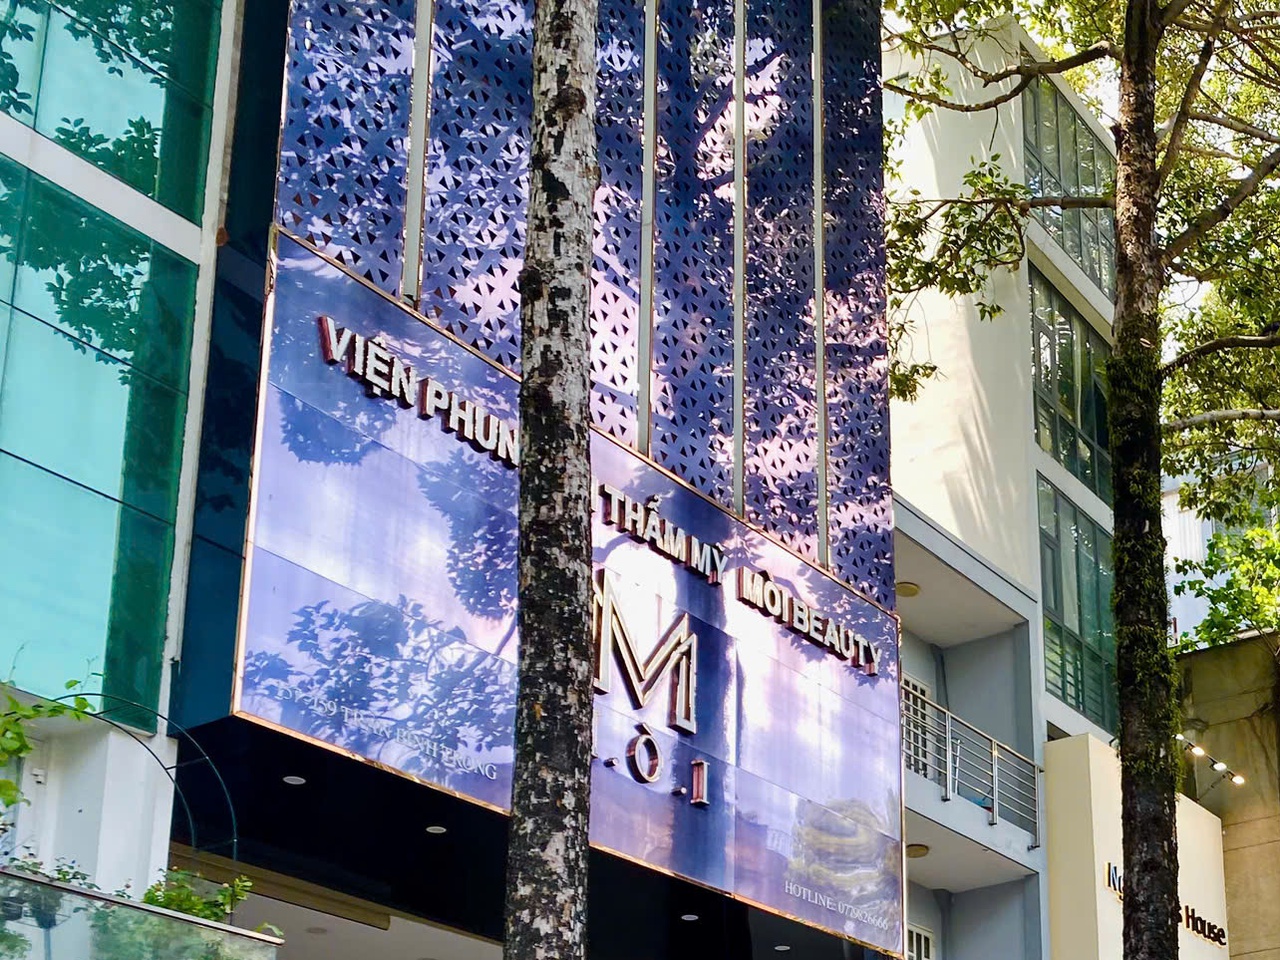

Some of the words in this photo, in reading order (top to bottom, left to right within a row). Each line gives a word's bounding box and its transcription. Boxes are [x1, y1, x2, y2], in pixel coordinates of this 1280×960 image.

[317, 316, 417, 408] VIỆN
[788, 597, 884, 676] BEAUTY
[784, 880, 836, 912] HOTLINE:
[1184, 904, 1227, 946] House
